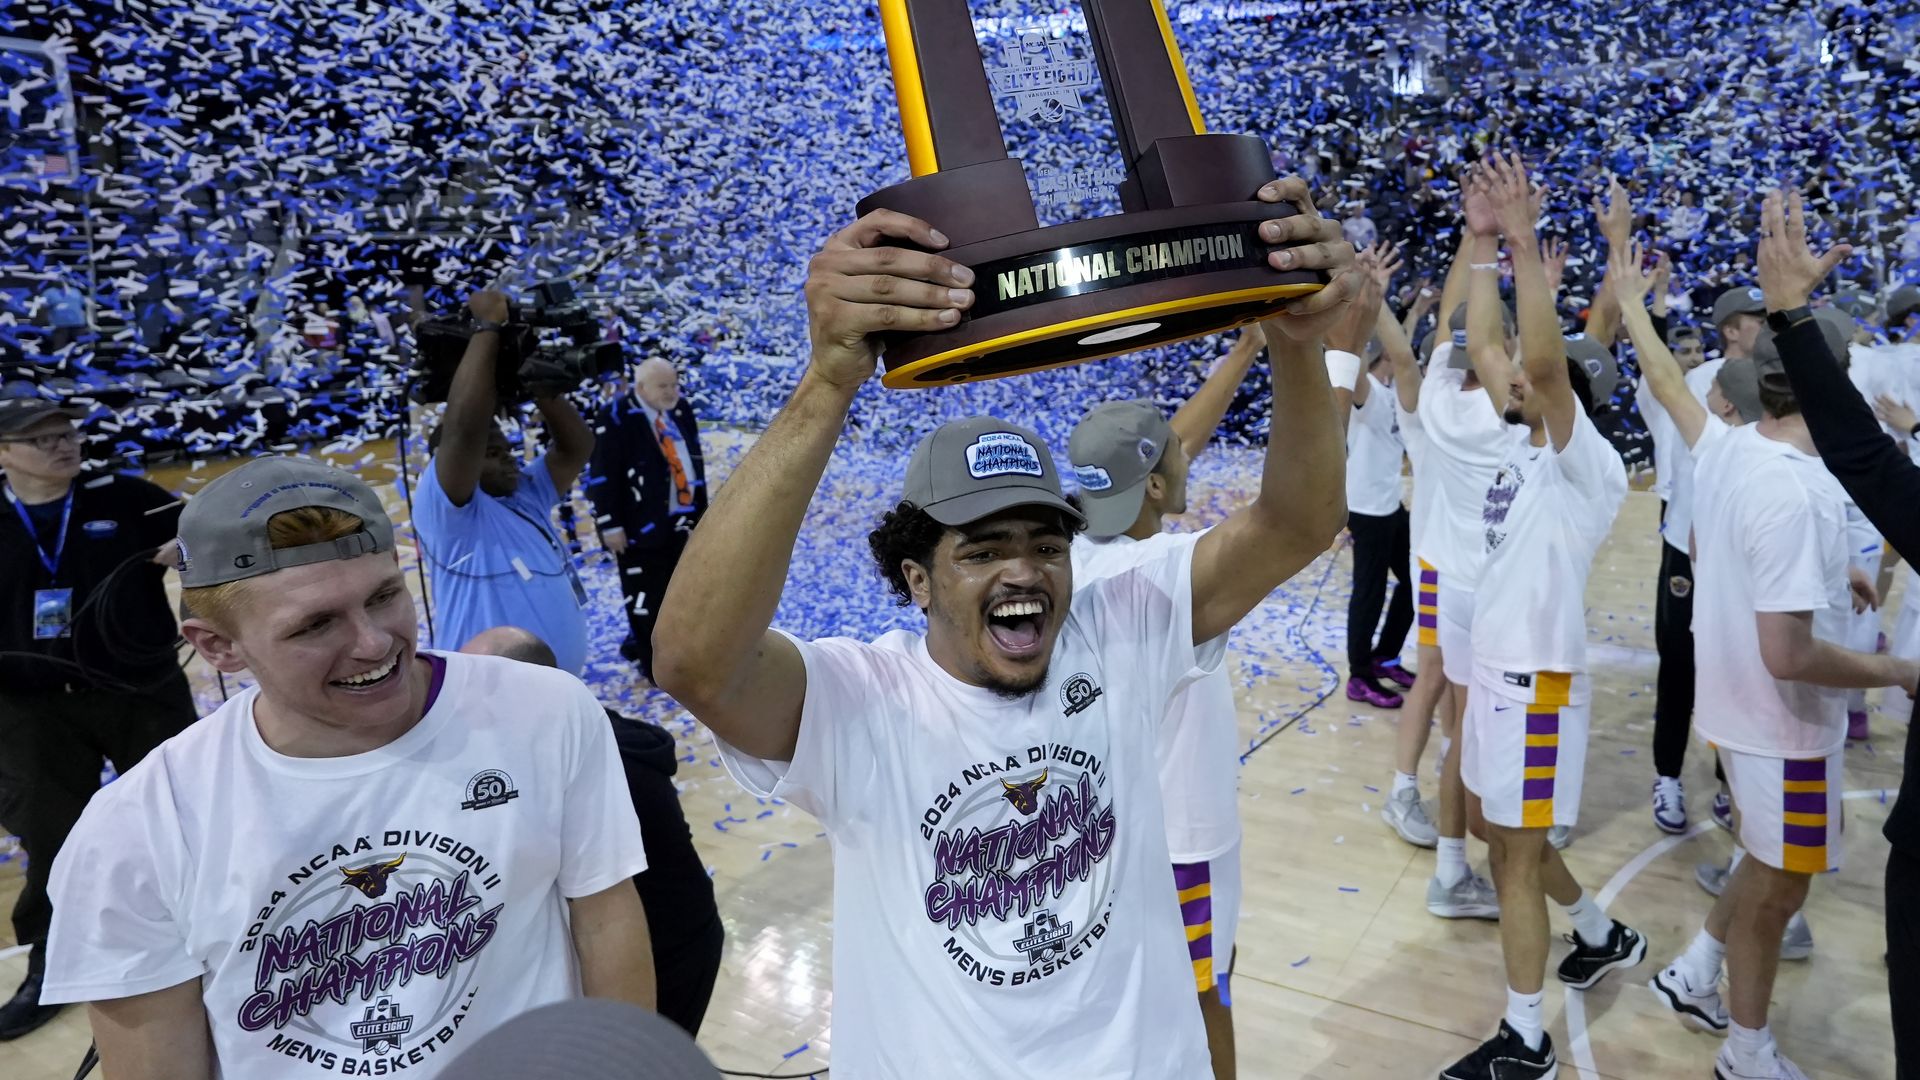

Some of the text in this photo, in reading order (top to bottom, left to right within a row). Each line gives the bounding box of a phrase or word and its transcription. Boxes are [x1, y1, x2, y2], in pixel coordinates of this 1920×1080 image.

[1003, 72, 1040, 89] ELITE
[997, 233, 1244, 301] NATIONAL CHAMPION
[972, 457, 1040, 473] CHAMPIONS
[976, 443, 1032, 461] NATIONAL
[1069, 682, 1091, 703] 50
[477, 781, 503, 801] 50
[920, 781, 962, 841] 2024
[962, 756, 1022, 786] NCAA
[1028, 742, 1102, 775] DIVISION
[934, 771, 1098, 881] NATIONAL
[239, 830, 501, 952] 2024 NCAA DIVISION II
[924, 797, 1116, 930] CHAMPIONS
[237, 903, 505, 1032] CHAMPIONS
[255, 869, 483, 992] NATIONAL
[943, 889, 1115, 986] MEN'S BASKETBA
[266, 985, 479, 1077] MEN'S BASKETBALL
[356, 1020, 409, 1036] ELITE EIGHT
